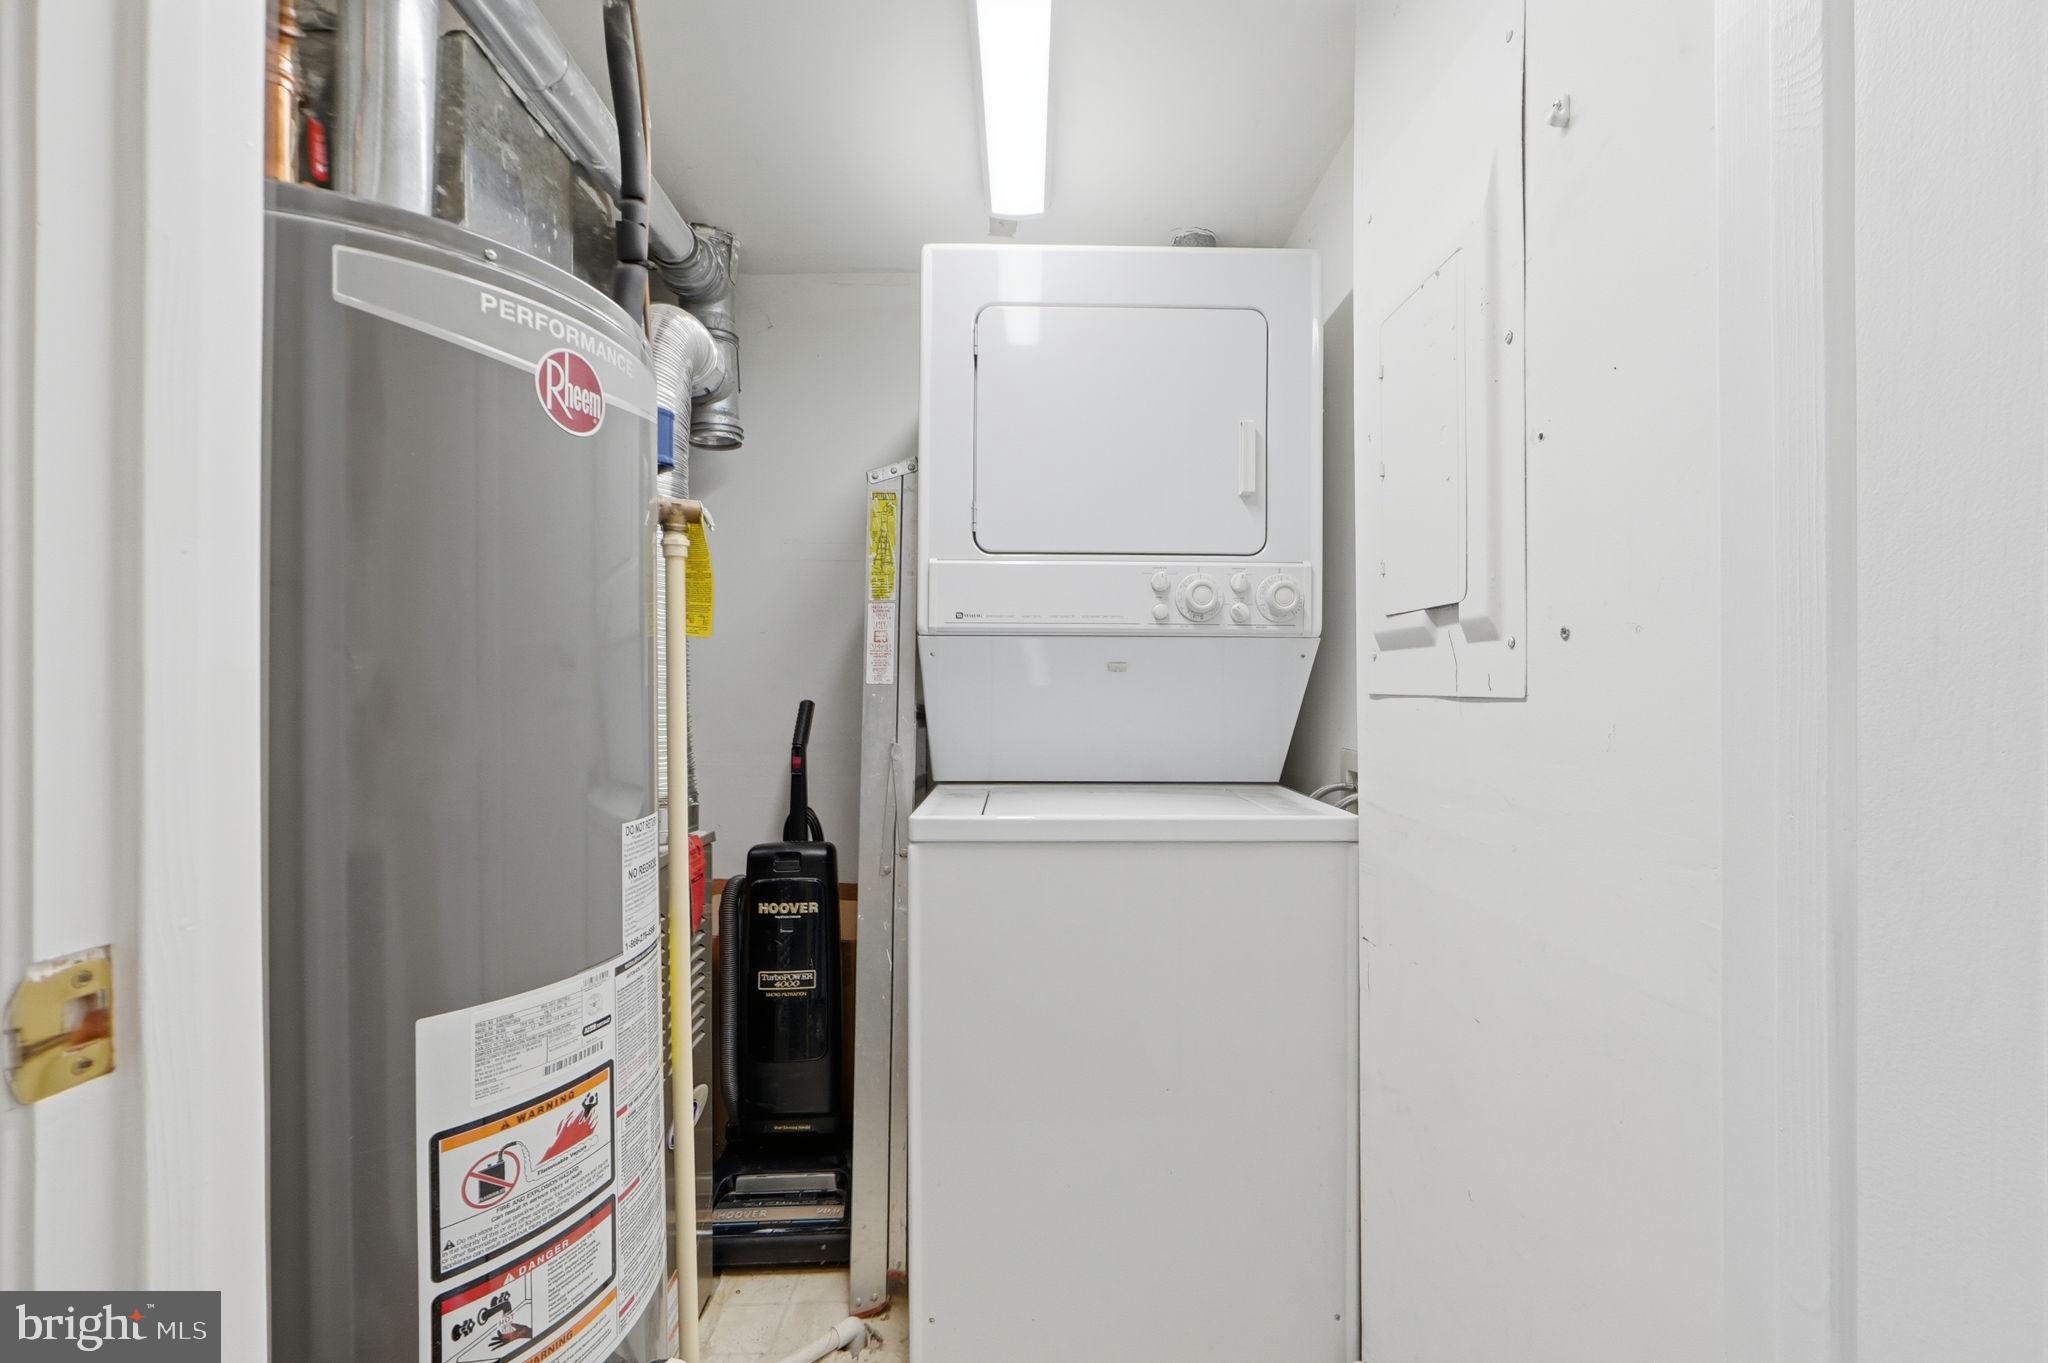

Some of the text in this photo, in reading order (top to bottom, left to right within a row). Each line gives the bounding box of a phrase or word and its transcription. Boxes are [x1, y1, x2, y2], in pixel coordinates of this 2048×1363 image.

[480, 292, 635, 378] PERFORMANCE
[546, 351, 602, 420] Rheem
[758, 902, 819, 914] HOOVER
[774, 980, 800, 988] 4000
[516, 1091, 575, 1124] WARNING
[512, 1196, 525, 1206] AND
[490, 1213, 503, 1222] Can
[718, 1208, 768, 1220] HOOVER
[519, 1239, 569, 1276] DANGER
